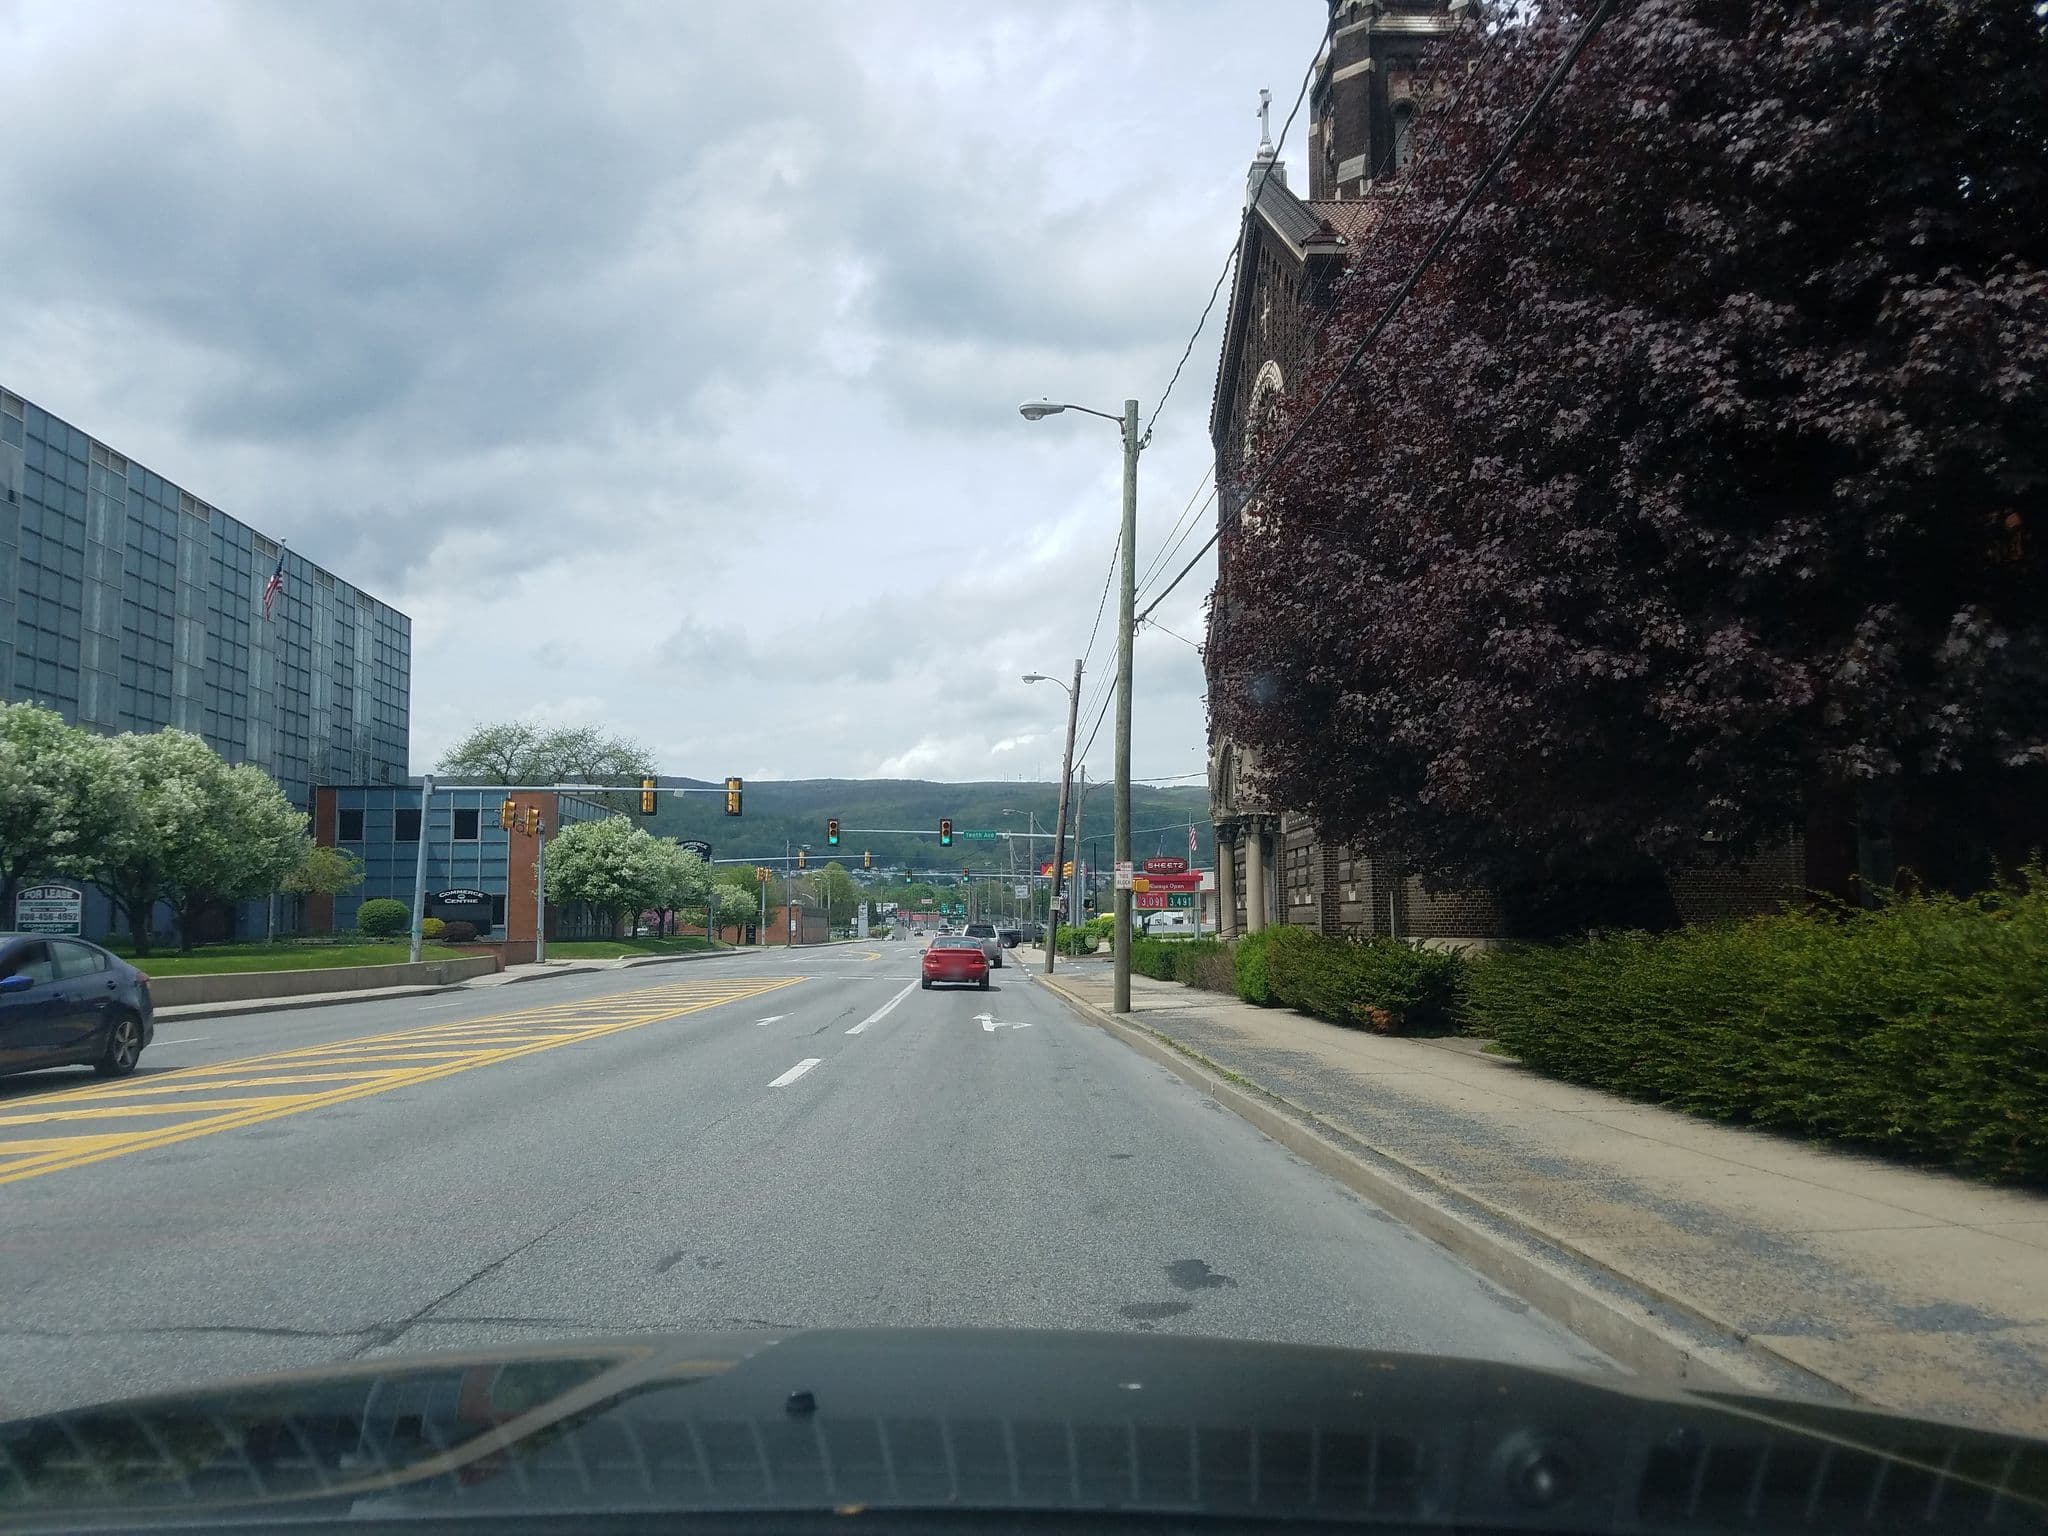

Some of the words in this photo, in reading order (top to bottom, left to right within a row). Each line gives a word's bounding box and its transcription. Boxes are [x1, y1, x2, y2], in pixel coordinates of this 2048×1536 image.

[24, 890, 42, 899] FOR
[44, 889, 74, 899] LEASE
[439, 890, 484, 898] COMMERCE
